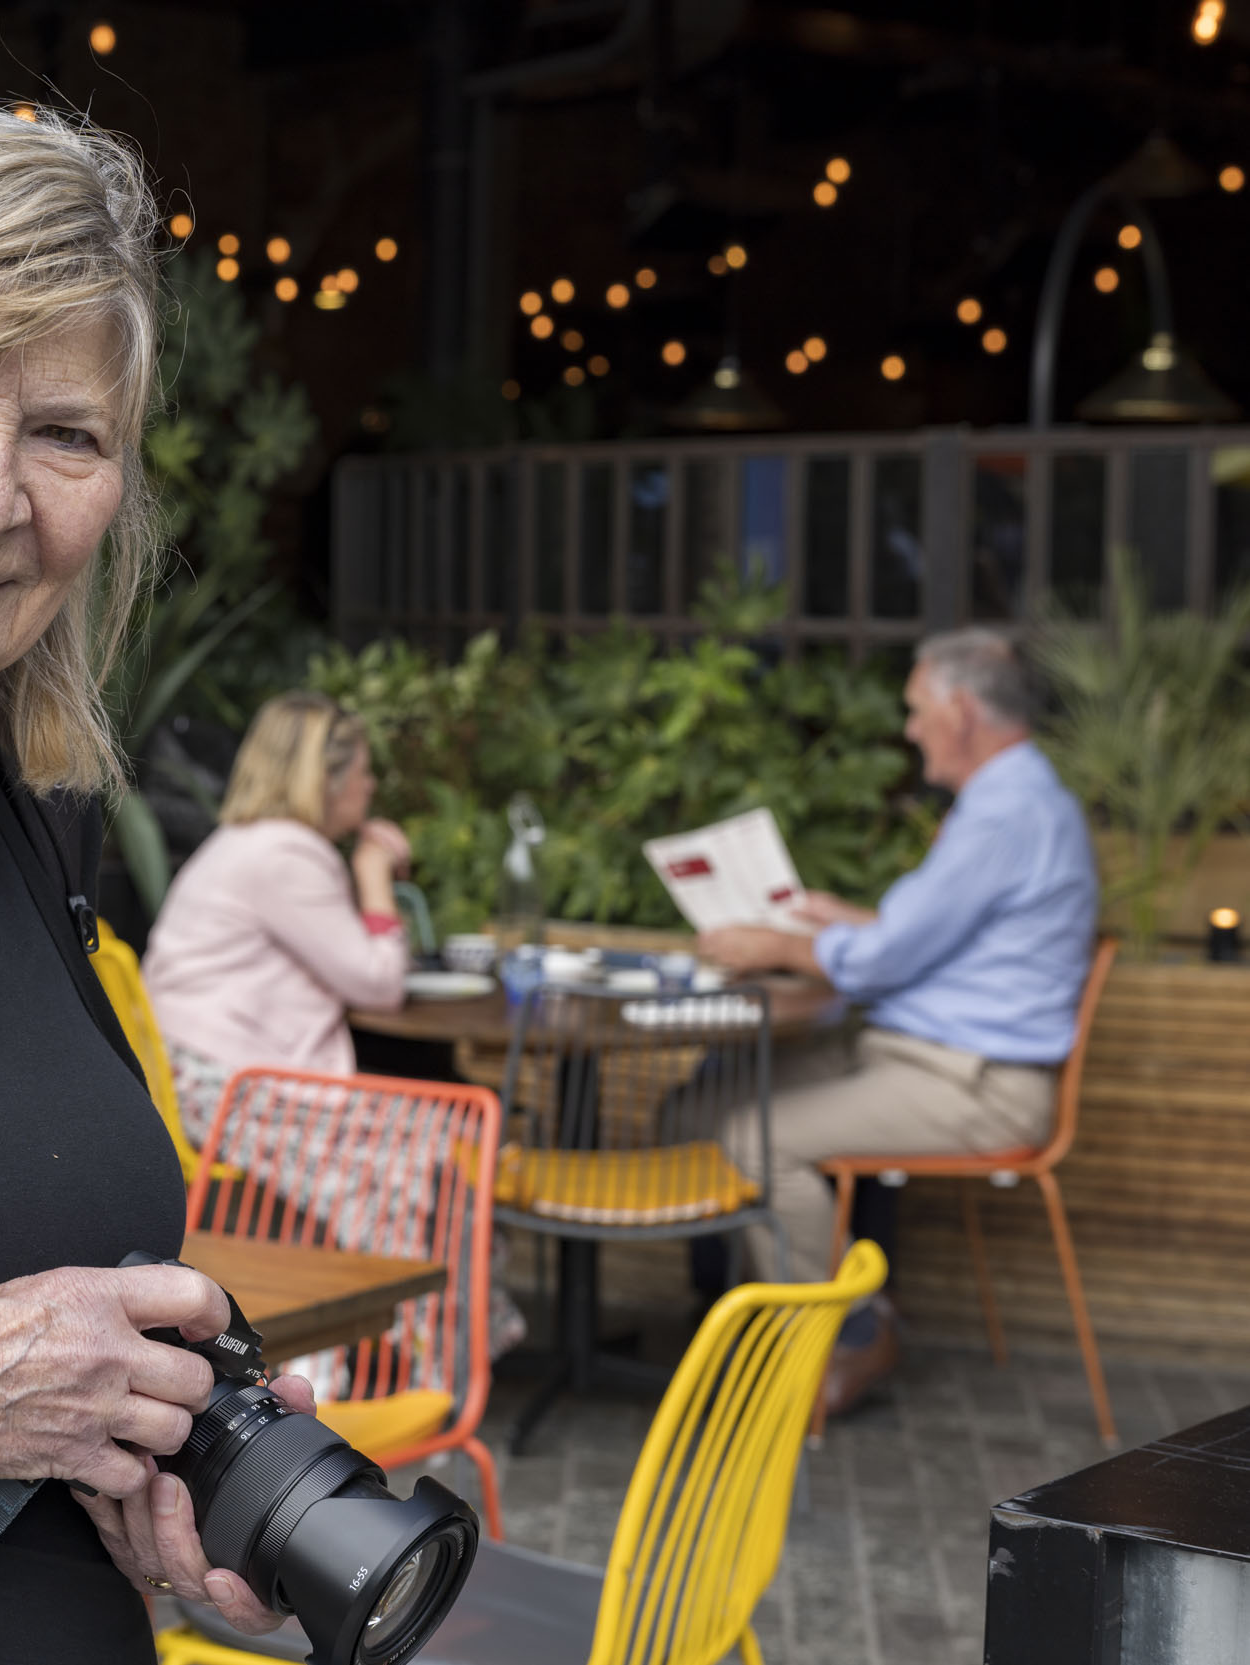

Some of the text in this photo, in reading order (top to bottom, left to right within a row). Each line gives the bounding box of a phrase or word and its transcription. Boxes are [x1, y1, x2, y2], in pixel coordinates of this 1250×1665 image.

[215, 1333, 249, 1355] FUJIFILM
[245, 1367, 262, 1378] X-T5
[258, 1416, 269, 1425] 23
[240, 1431, 252, 1441] 16
[349, 1566, 368, 1591] 16-55
